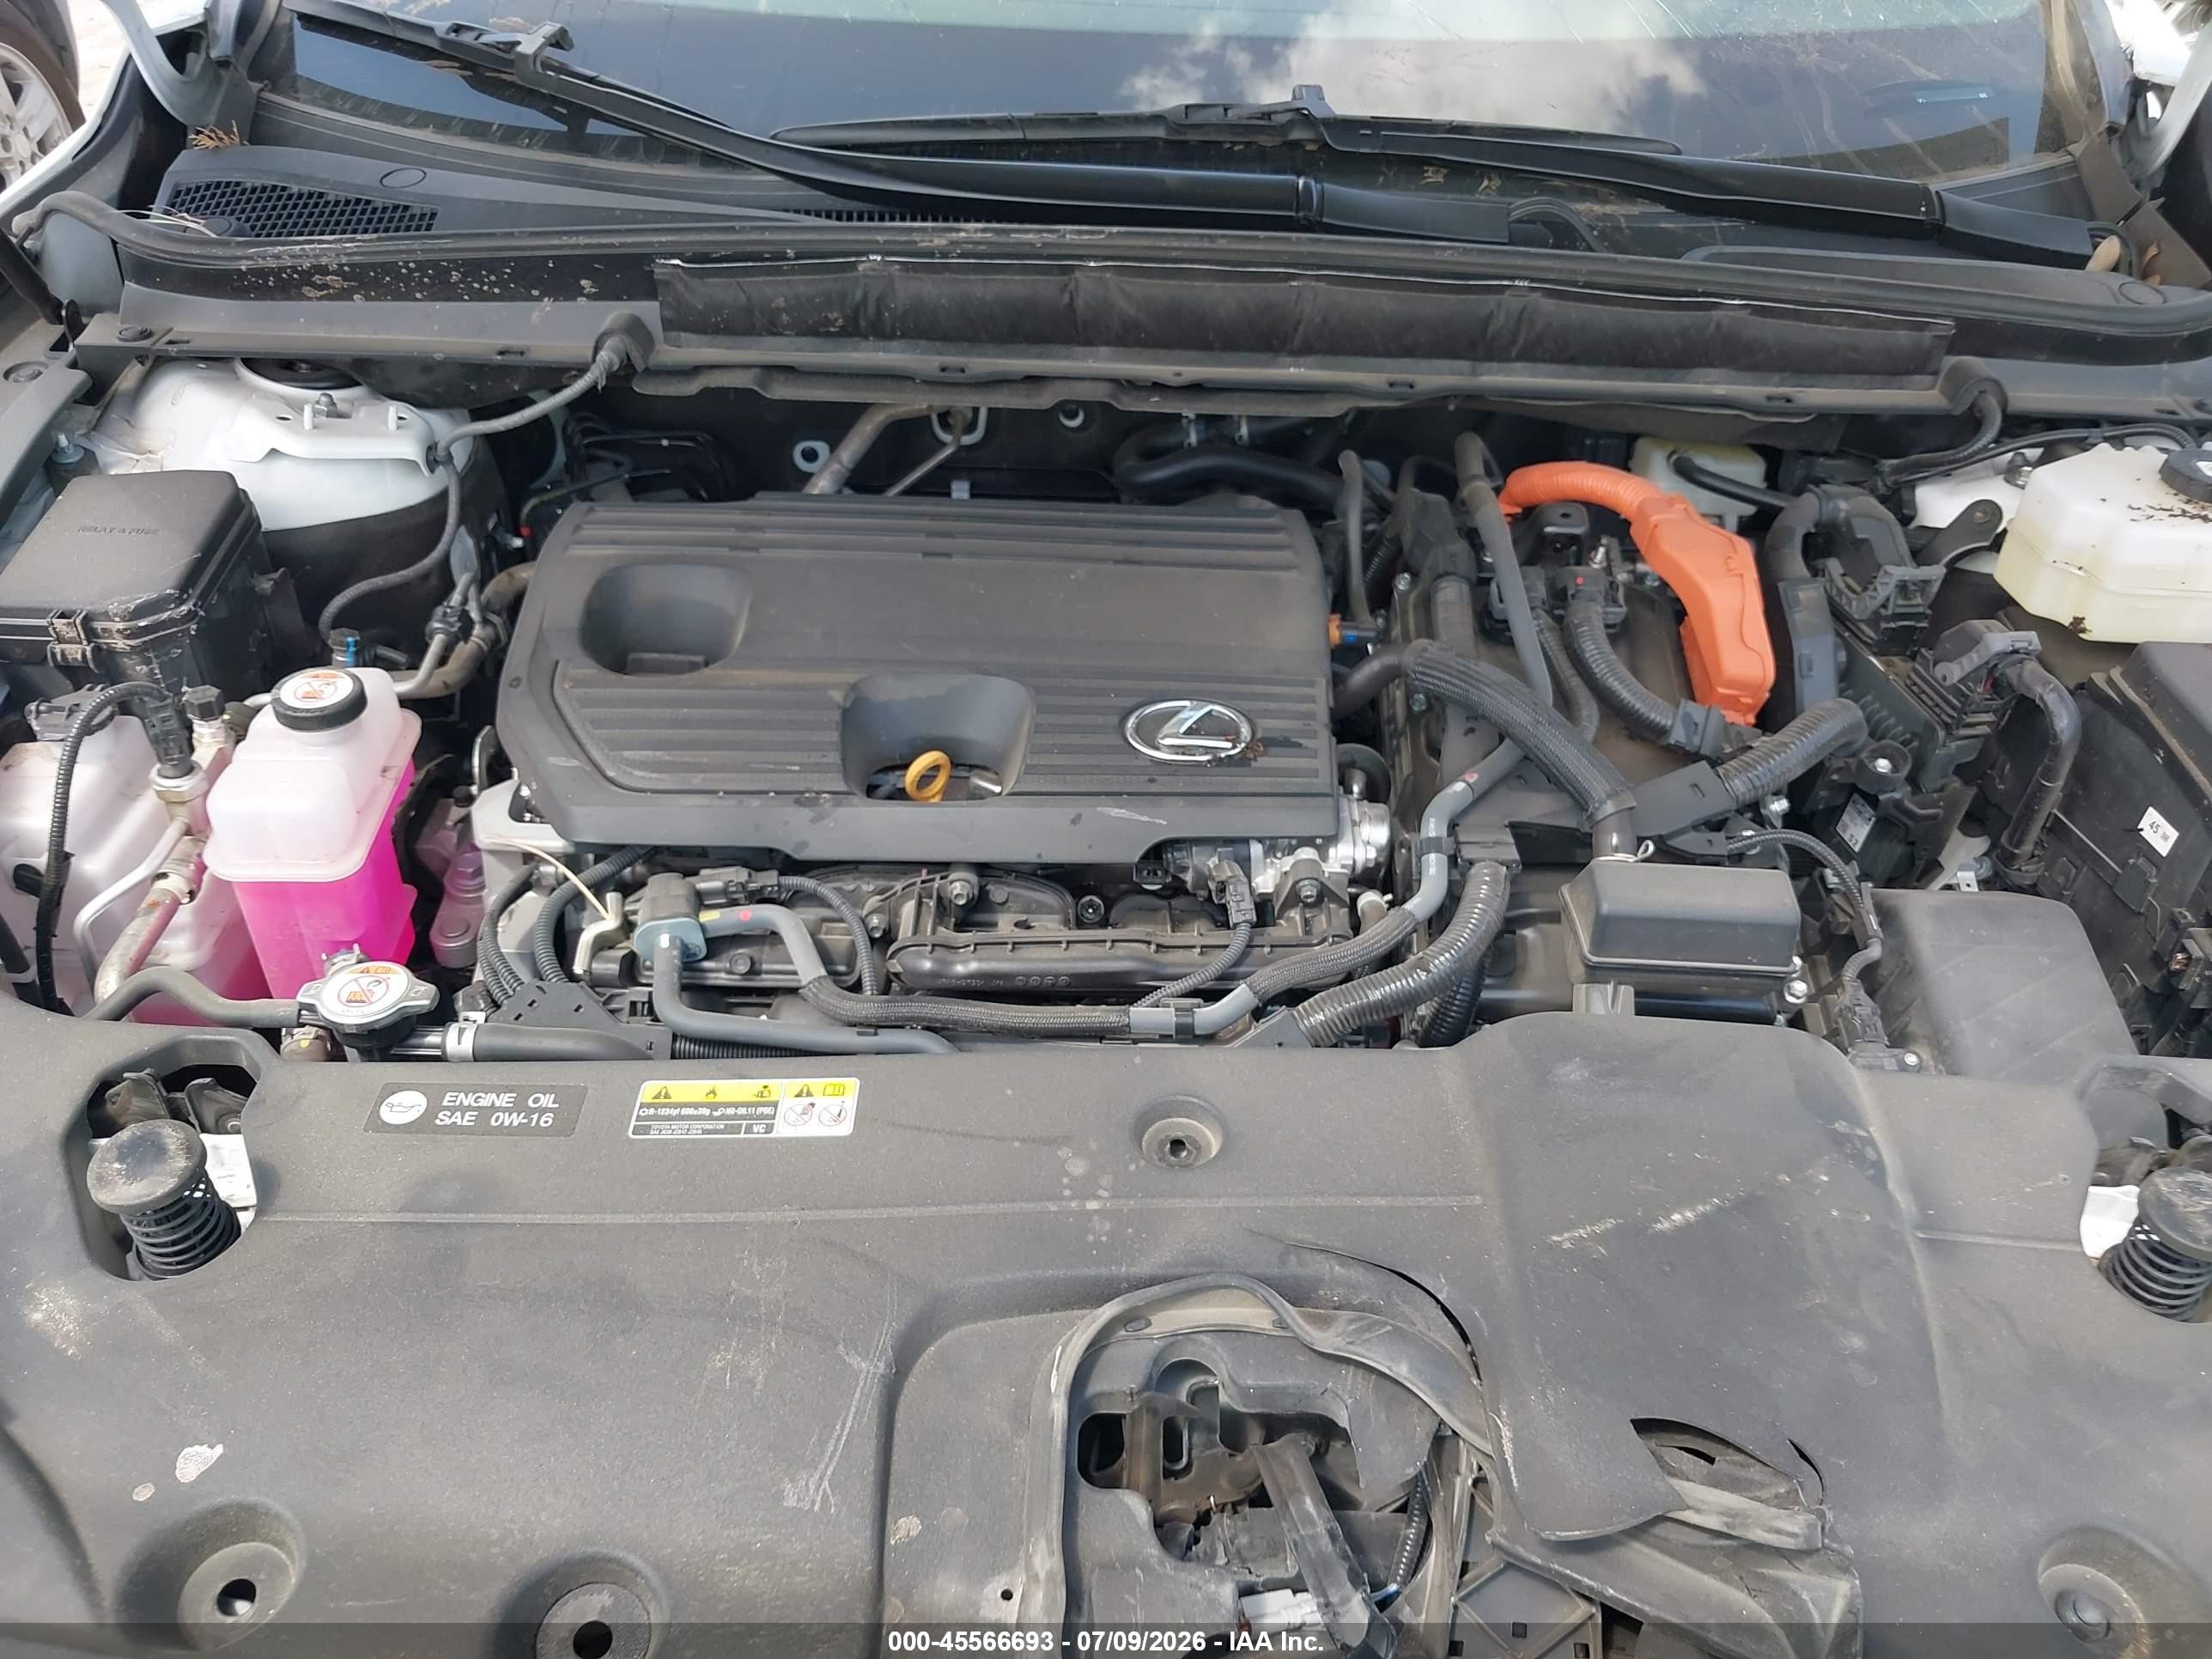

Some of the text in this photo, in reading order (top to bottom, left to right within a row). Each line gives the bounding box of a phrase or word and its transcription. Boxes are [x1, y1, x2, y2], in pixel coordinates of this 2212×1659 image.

[441, 1091, 560, 1108] ENGINE OIL
[434, 1110, 554, 1127] SAE 0W-16
[752, 1124, 766, 1133] VC
